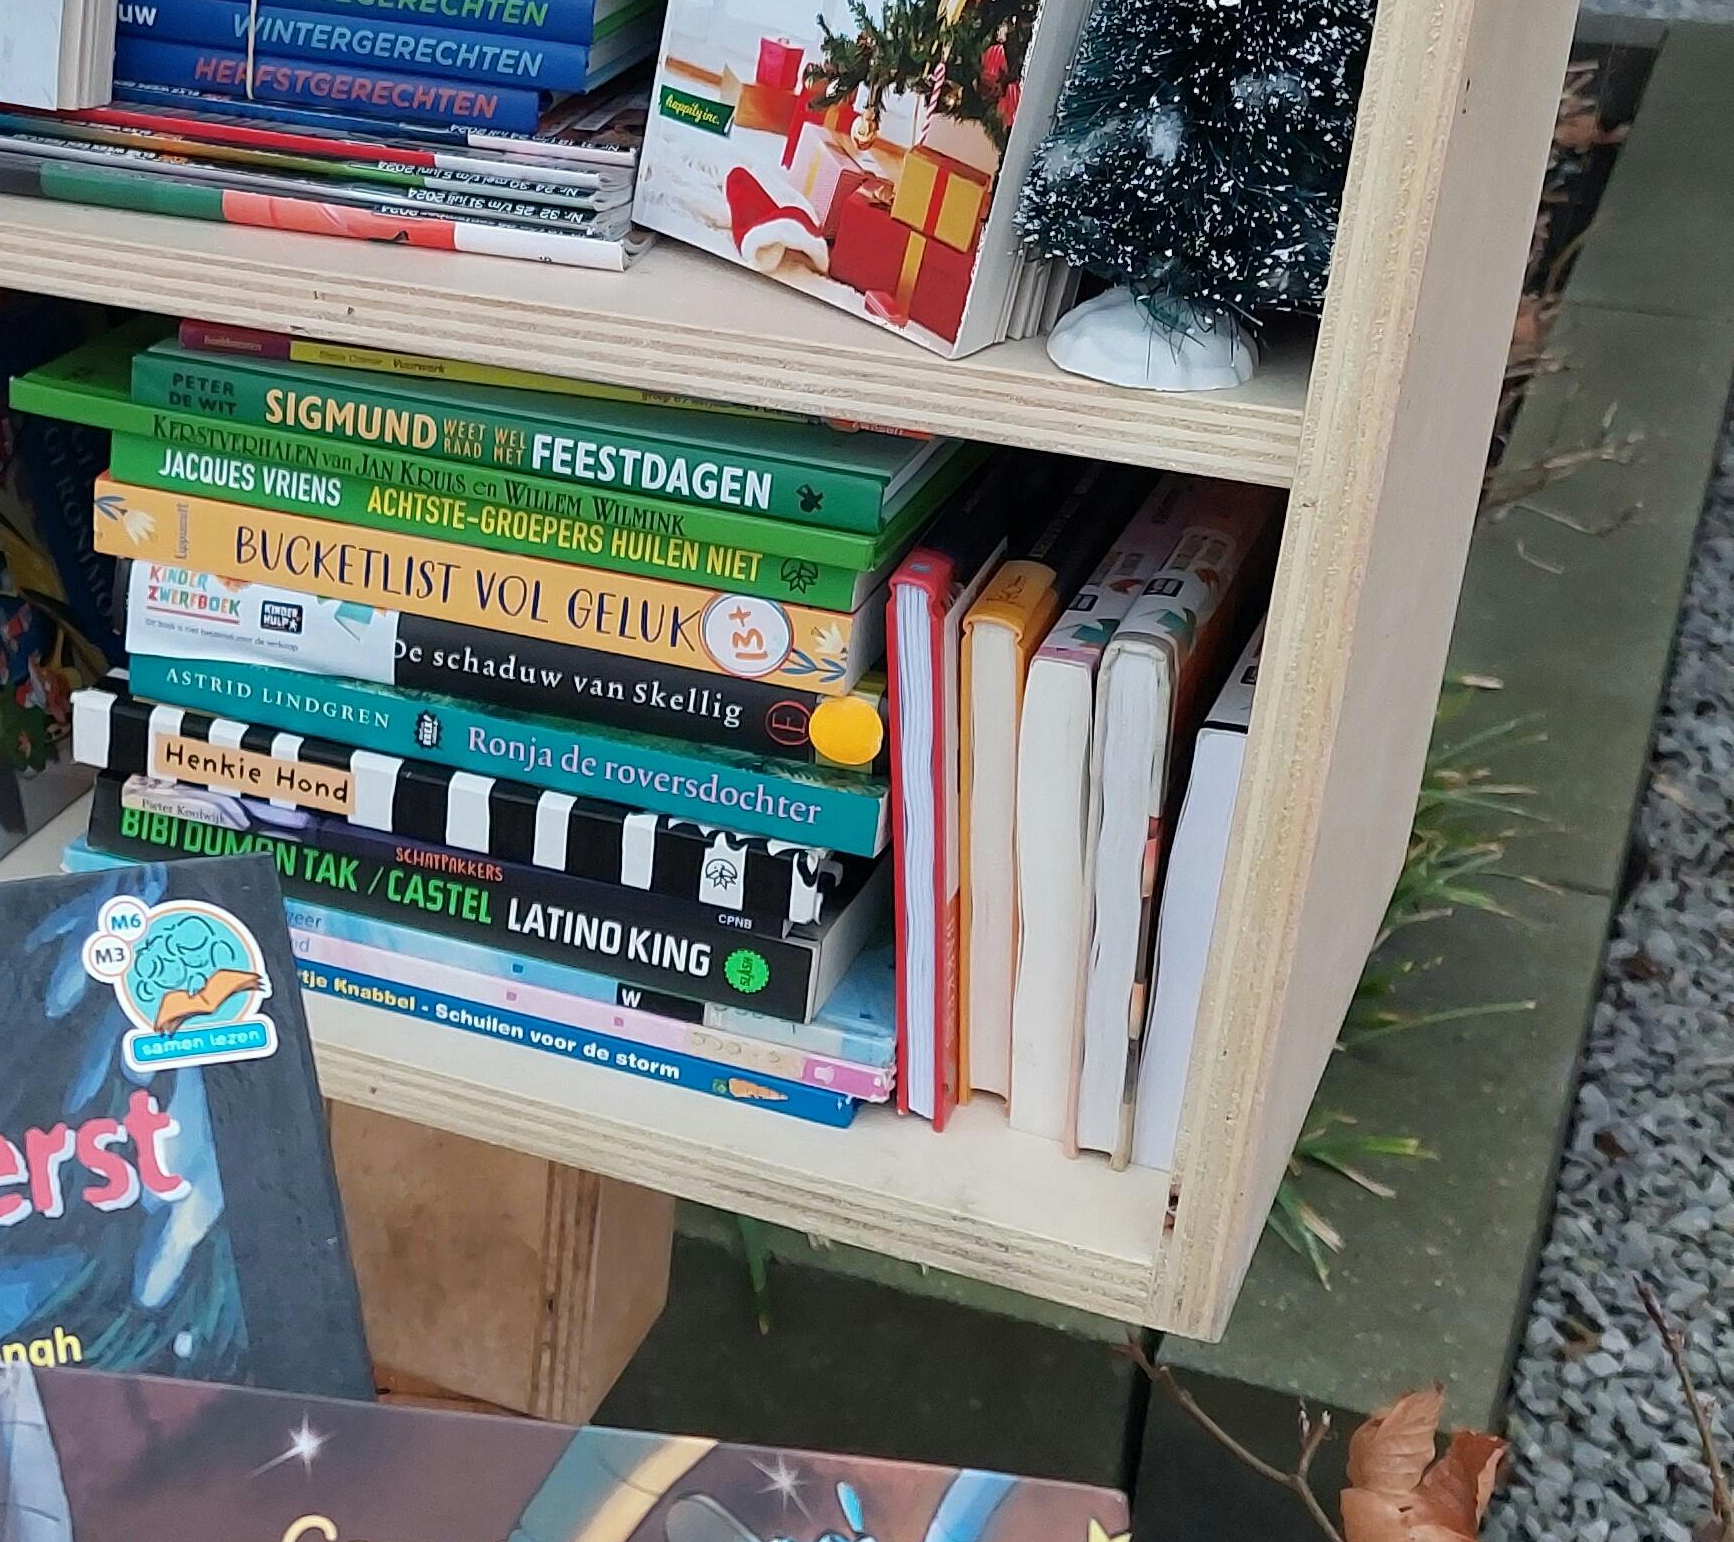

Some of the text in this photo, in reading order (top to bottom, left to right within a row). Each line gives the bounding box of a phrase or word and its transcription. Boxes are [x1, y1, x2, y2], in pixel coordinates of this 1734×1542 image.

[233, 13, 544, 78] WINTERGERECHTEN
[172, 373, 235, 397] PETER
[169, 391, 238, 416] DE WIT
[266, 387, 437, 450] SIGMUND
[443, 418, 527, 450] WEET WEL
[443, 438, 524, 466] RAAD MET
[152, 414, 687, 537] KERSTVERHALEN van JAN KRUIS en WILLEM WILMINK
[158, 448, 342, 507] JACQUES VRIENS
[530, 432, 774, 512] FEESTDAGEN
[366, 483, 764, 584] ACHTSTE-GROEPERS HUILEN NIET
[149, 565, 208, 592] KINDER
[236, 525, 462, 605] BUCKETLIST
[476, 568, 550, 623] VOL
[567, 587, 702, 652] GELUK
[146, 585, 241, 617] ZWERFBOEK
[264, 604, 299, 618] KINDER
[263, 614, 290, 628] HULP
[395, 639, 744, 729] De schaduw van Skellig
[166, 666, 253, 700] ASTRID
[262, 687, 391, 729] LINDGREN
[467, 726, 553, 772] Ronja
[561, 744, 597, 777] de
[605, 762, 822, 825] roversdochter
[165, 742, 350, 803] Henkie Hond
[141, 797, 225, 824] Pieter Koolwijk
[394, 846, 503, 882] SCHATPAKKERS
[121, 808, 178, 848] BIBI
[303, 848, 359, 893] TAK
[386, 869, 494, 924] CASTEL
[507, 897, 621, 955] LATINO
[627, 926, 713, 977] KING
[110, 914, 142, 931] M6
[718, 913, 752, 930] CPNB
[95, 947, 126, 965] M3
[142, 1029, 260, 1055] samen lezen
[333, 979, 416, 1013] Knabbel
[435, 1003, 524, 1040] Schuilen
[529, 1028, 578, 1054] voor
[582, 1040, 610, 1062] de
[614, 1052, 680, 1080] storm
